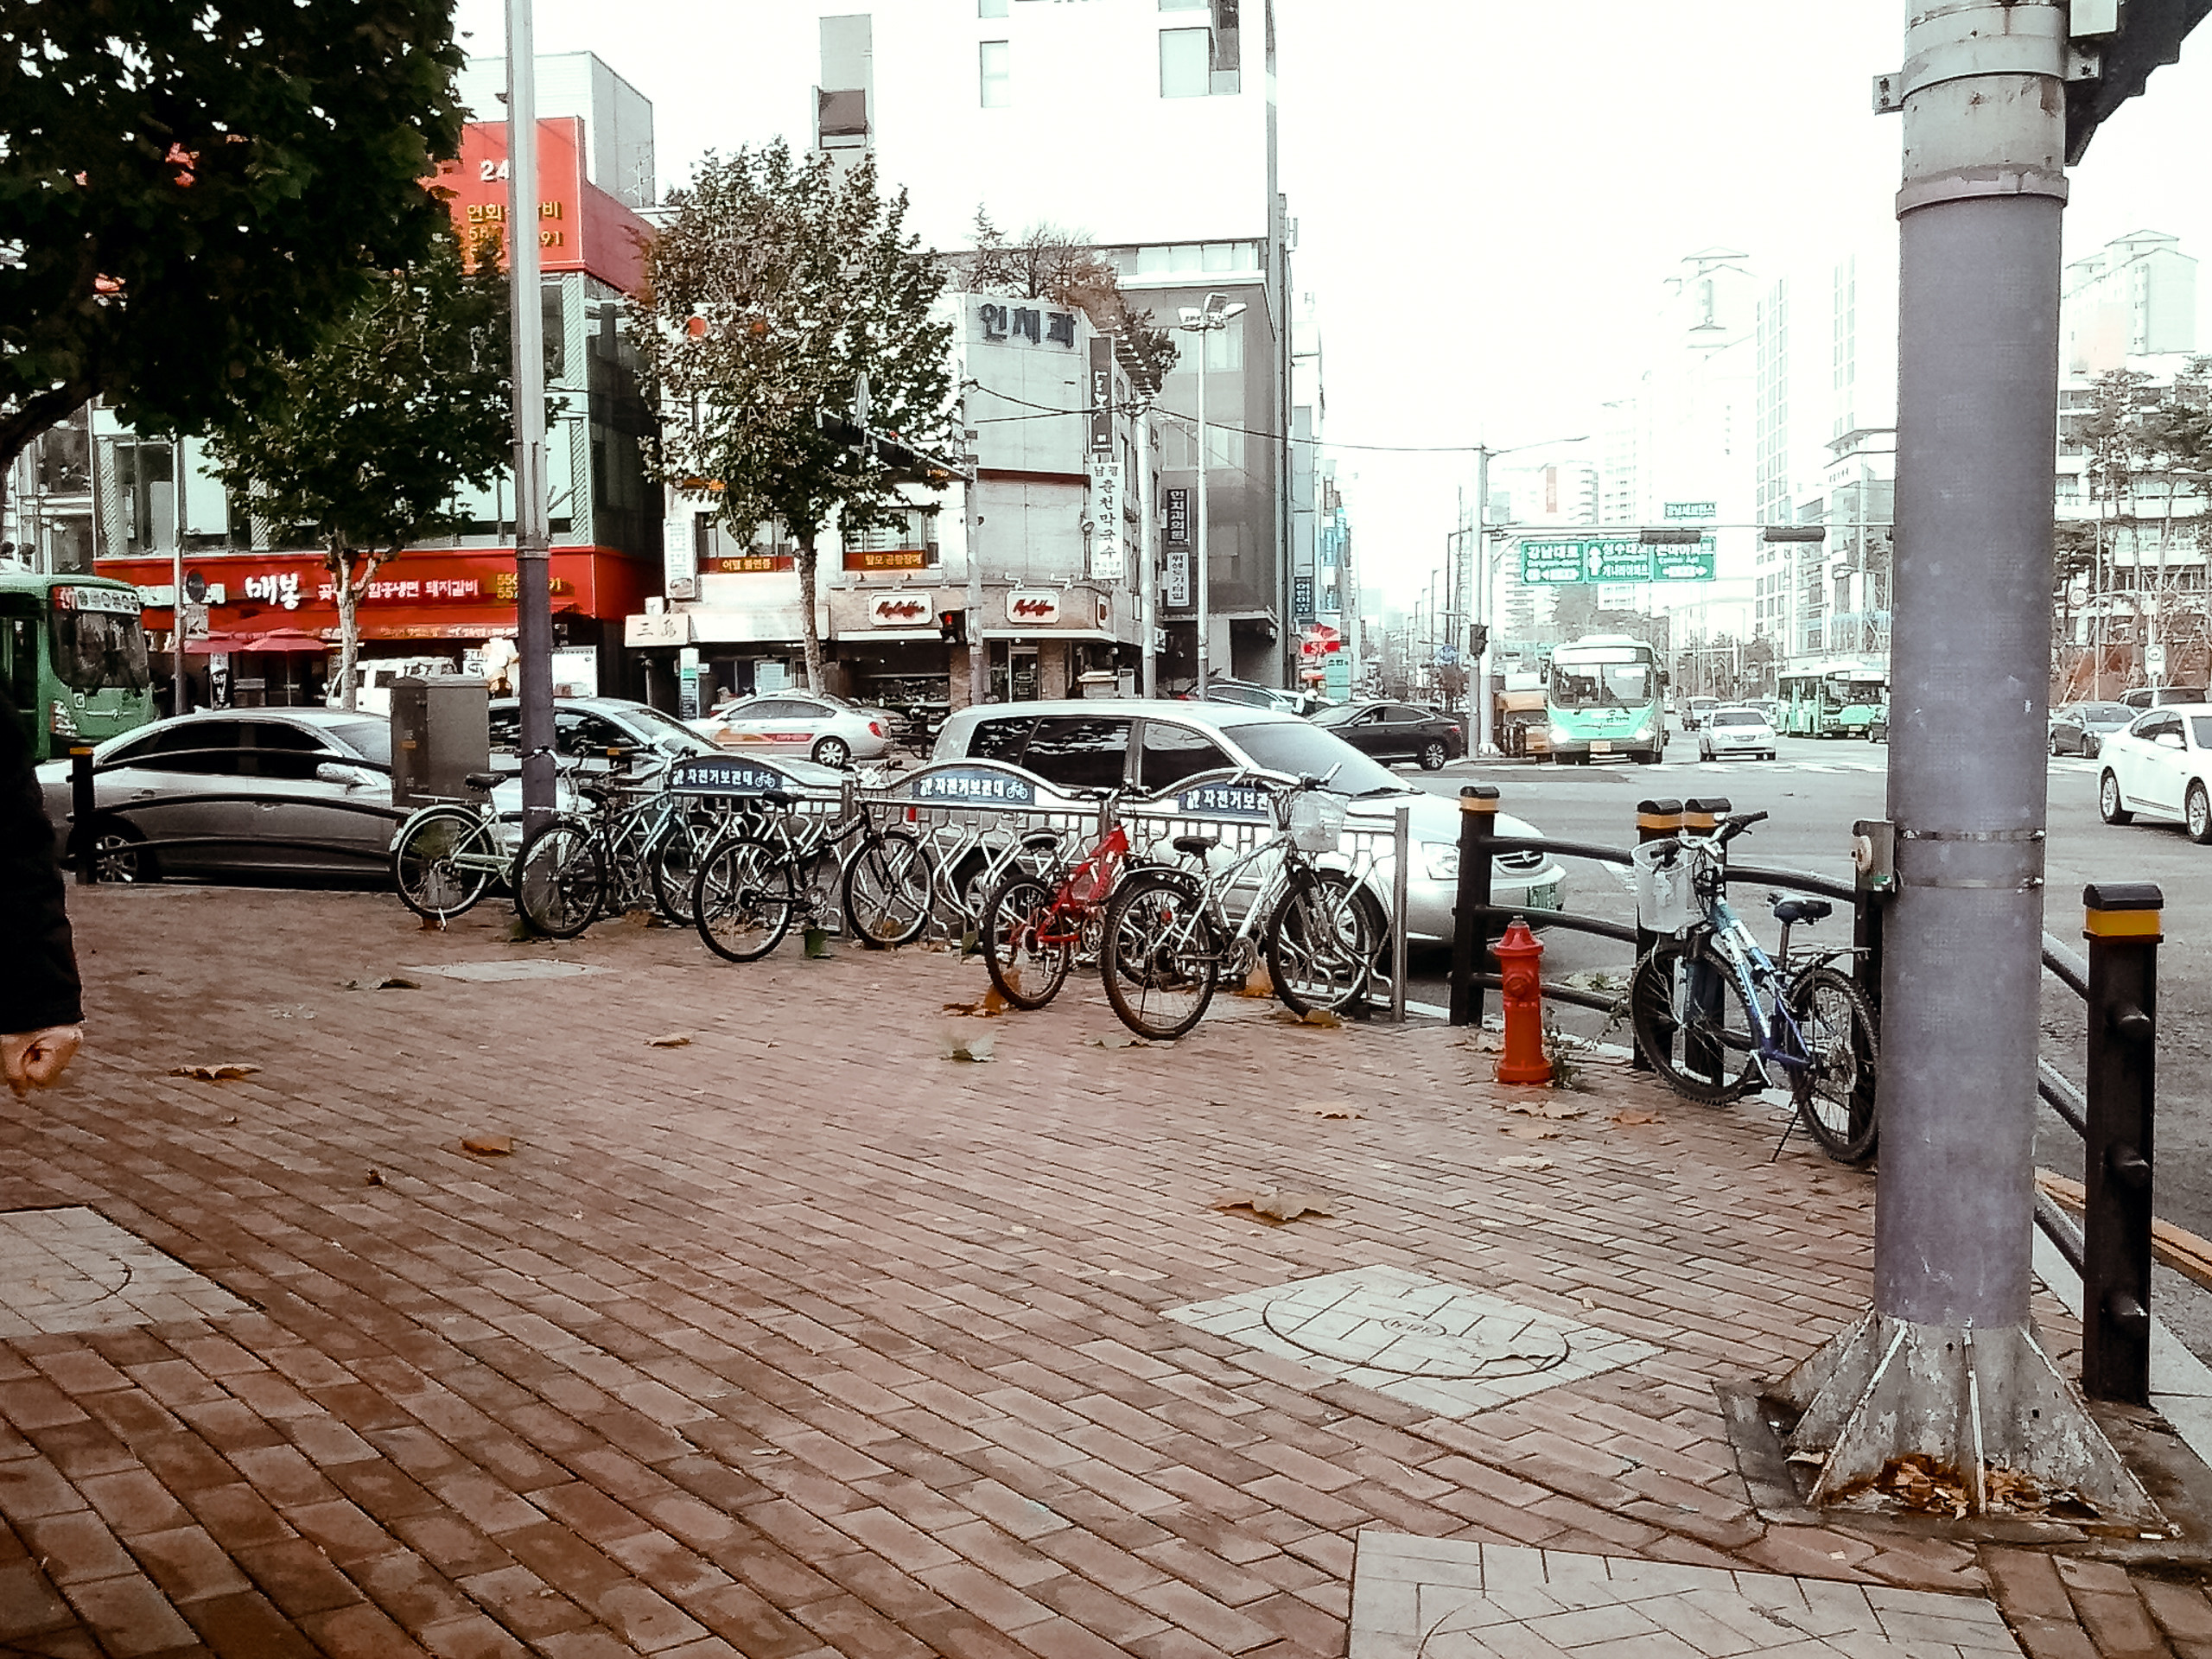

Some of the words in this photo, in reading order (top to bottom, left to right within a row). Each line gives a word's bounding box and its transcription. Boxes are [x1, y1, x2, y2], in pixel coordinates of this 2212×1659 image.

[1527, 544, 1580, 560] 강남대로
[244, 572, 302, 611] 매봉
[425, 578, 480, 597] 돼지갈비
[687, 768, 753, 786] 자전거보관대
[935, 777, 1004, 798] 자전거보관대
[1204, 789, 1268, 811] 자전거보관
